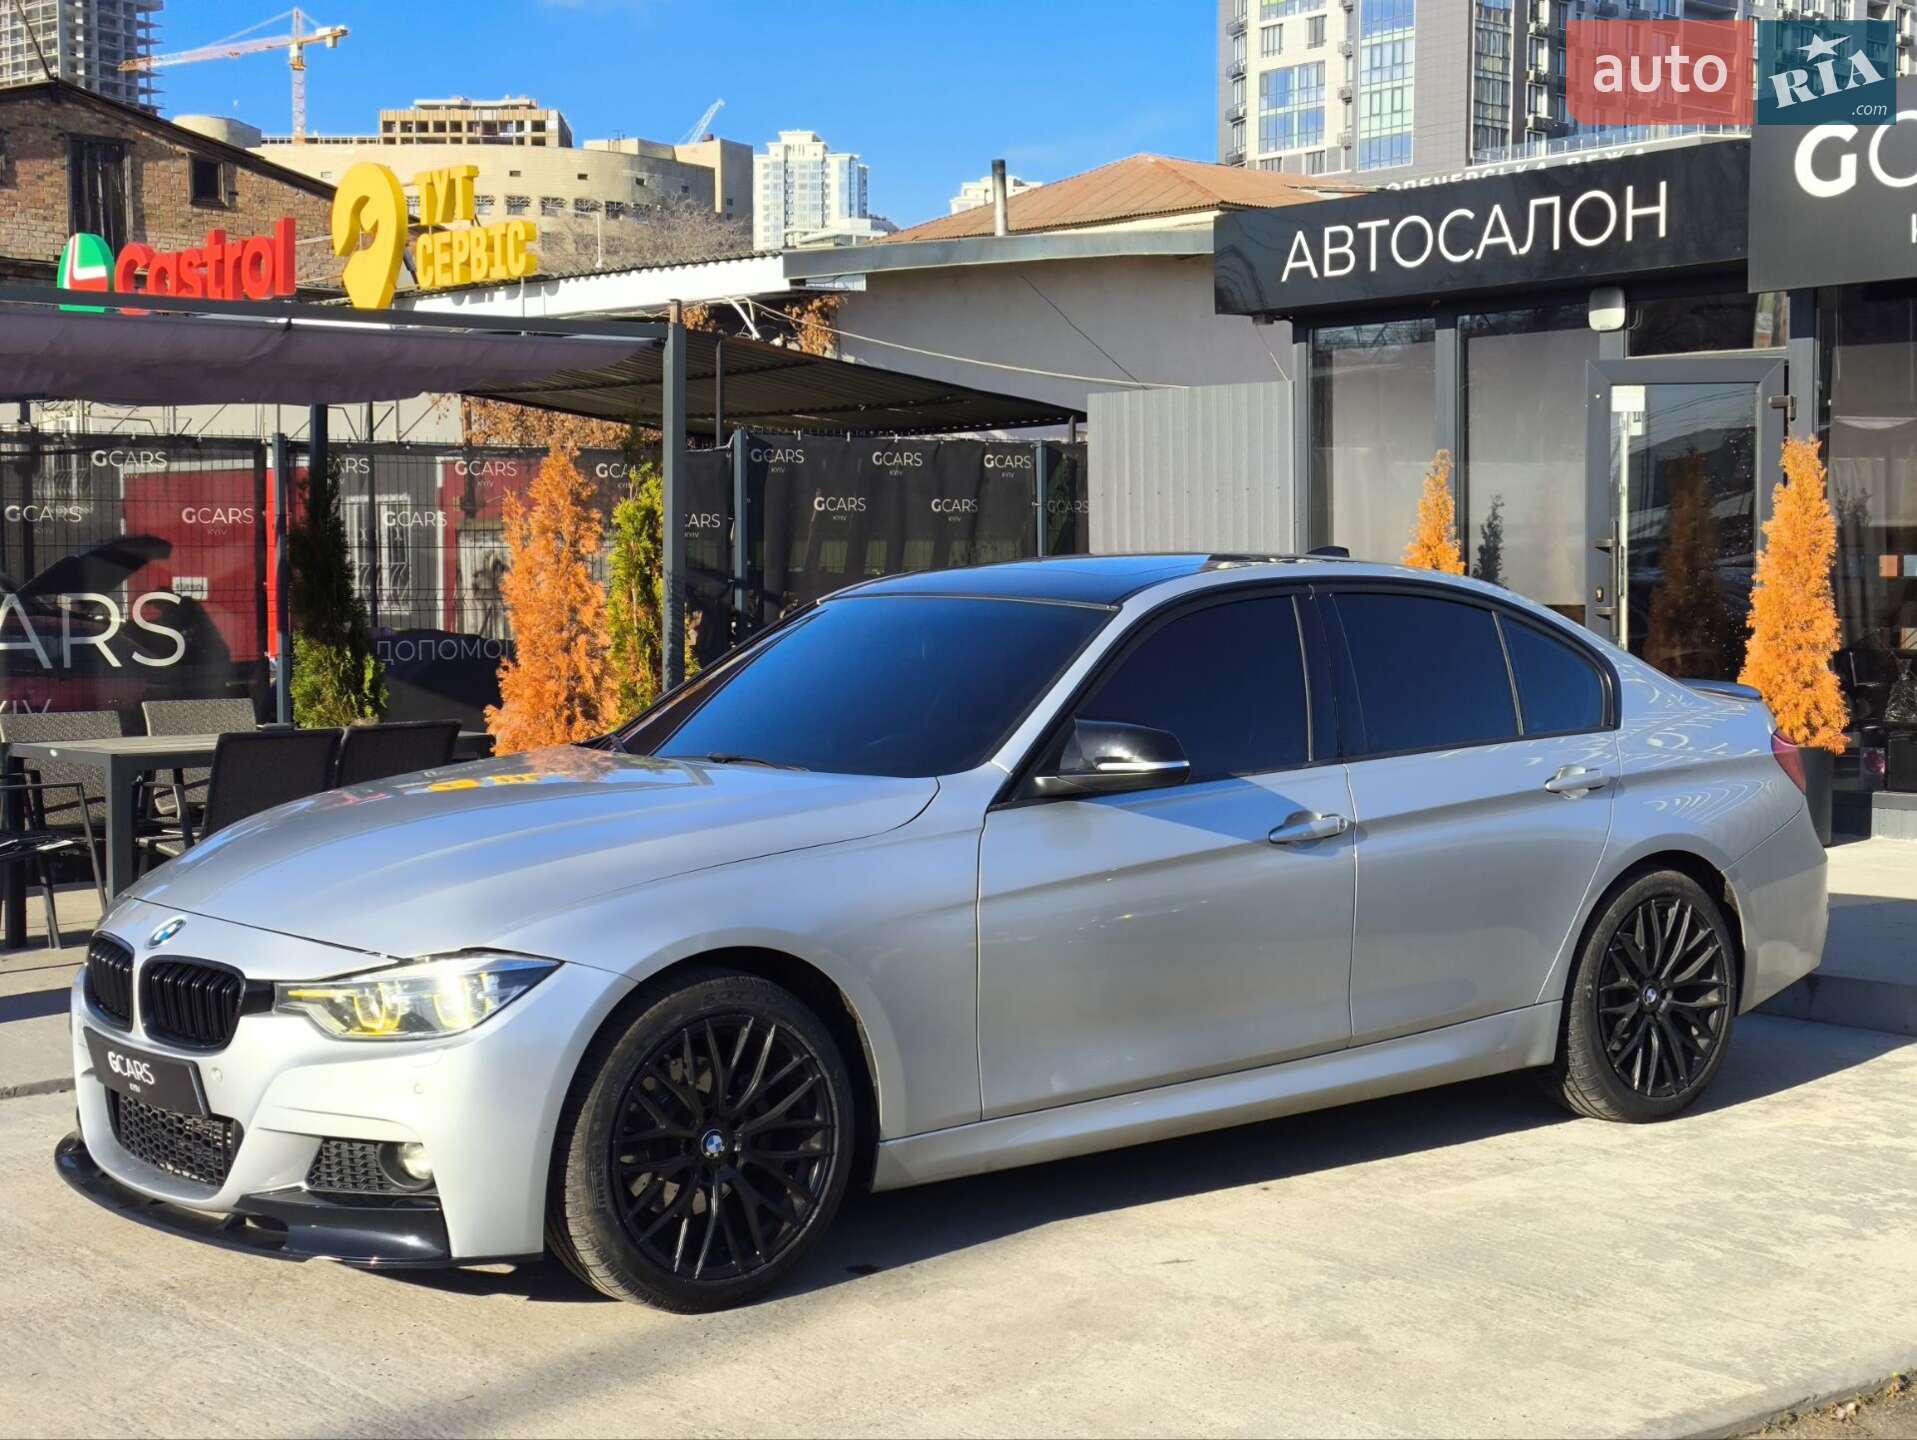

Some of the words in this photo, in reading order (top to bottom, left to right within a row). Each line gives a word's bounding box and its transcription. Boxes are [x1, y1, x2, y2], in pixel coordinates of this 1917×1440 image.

[414, 165, 480, 226] ТУТ
[1281, 180, 1668, 282] АВТОСАЛОН
[416, 219, 538, 290] СЕРВІС
[114, 217, 297, 315] Castrol
[91, 450, 168, 467] GCARS
[750, 448, 805, 465] GCARS
[872, 451, 924, 467] GCARS
[984, 454, 1033, 469] GCARS
[455, 460, 518, 477] GCARS
[814, 496, 867, 513] GCARS
[931, 499, 979, 513] GCARS
[181, 507, 255, 525] GCARS
[107, 1051, 156, 1086] GCARS
